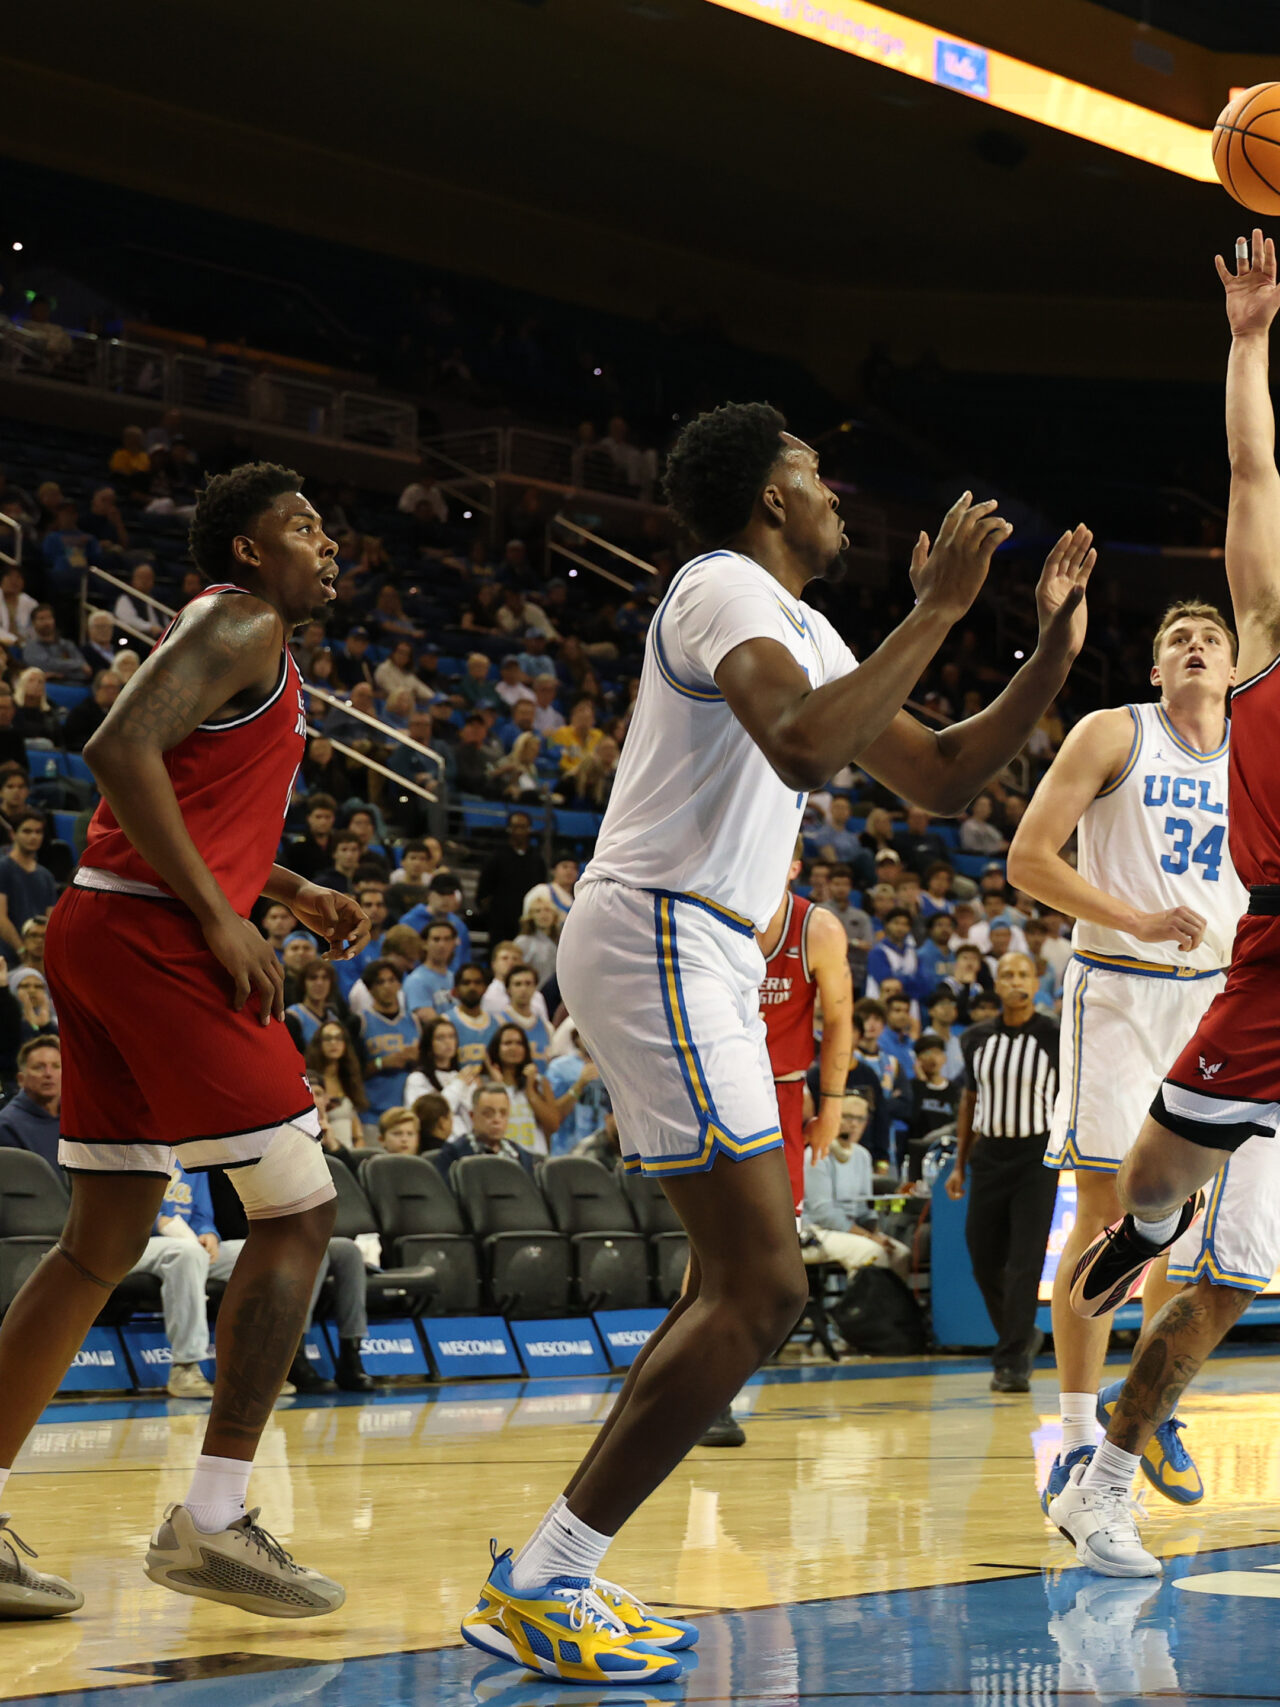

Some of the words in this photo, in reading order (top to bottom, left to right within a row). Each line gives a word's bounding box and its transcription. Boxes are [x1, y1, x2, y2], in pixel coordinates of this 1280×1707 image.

[1143, 775, 1228, 816] UCL
[1160, 816, 1226, 881] 34
[438, 1340, 492, 1356] WESCOM
[525, 1341, 579, 1357] WESCOM
